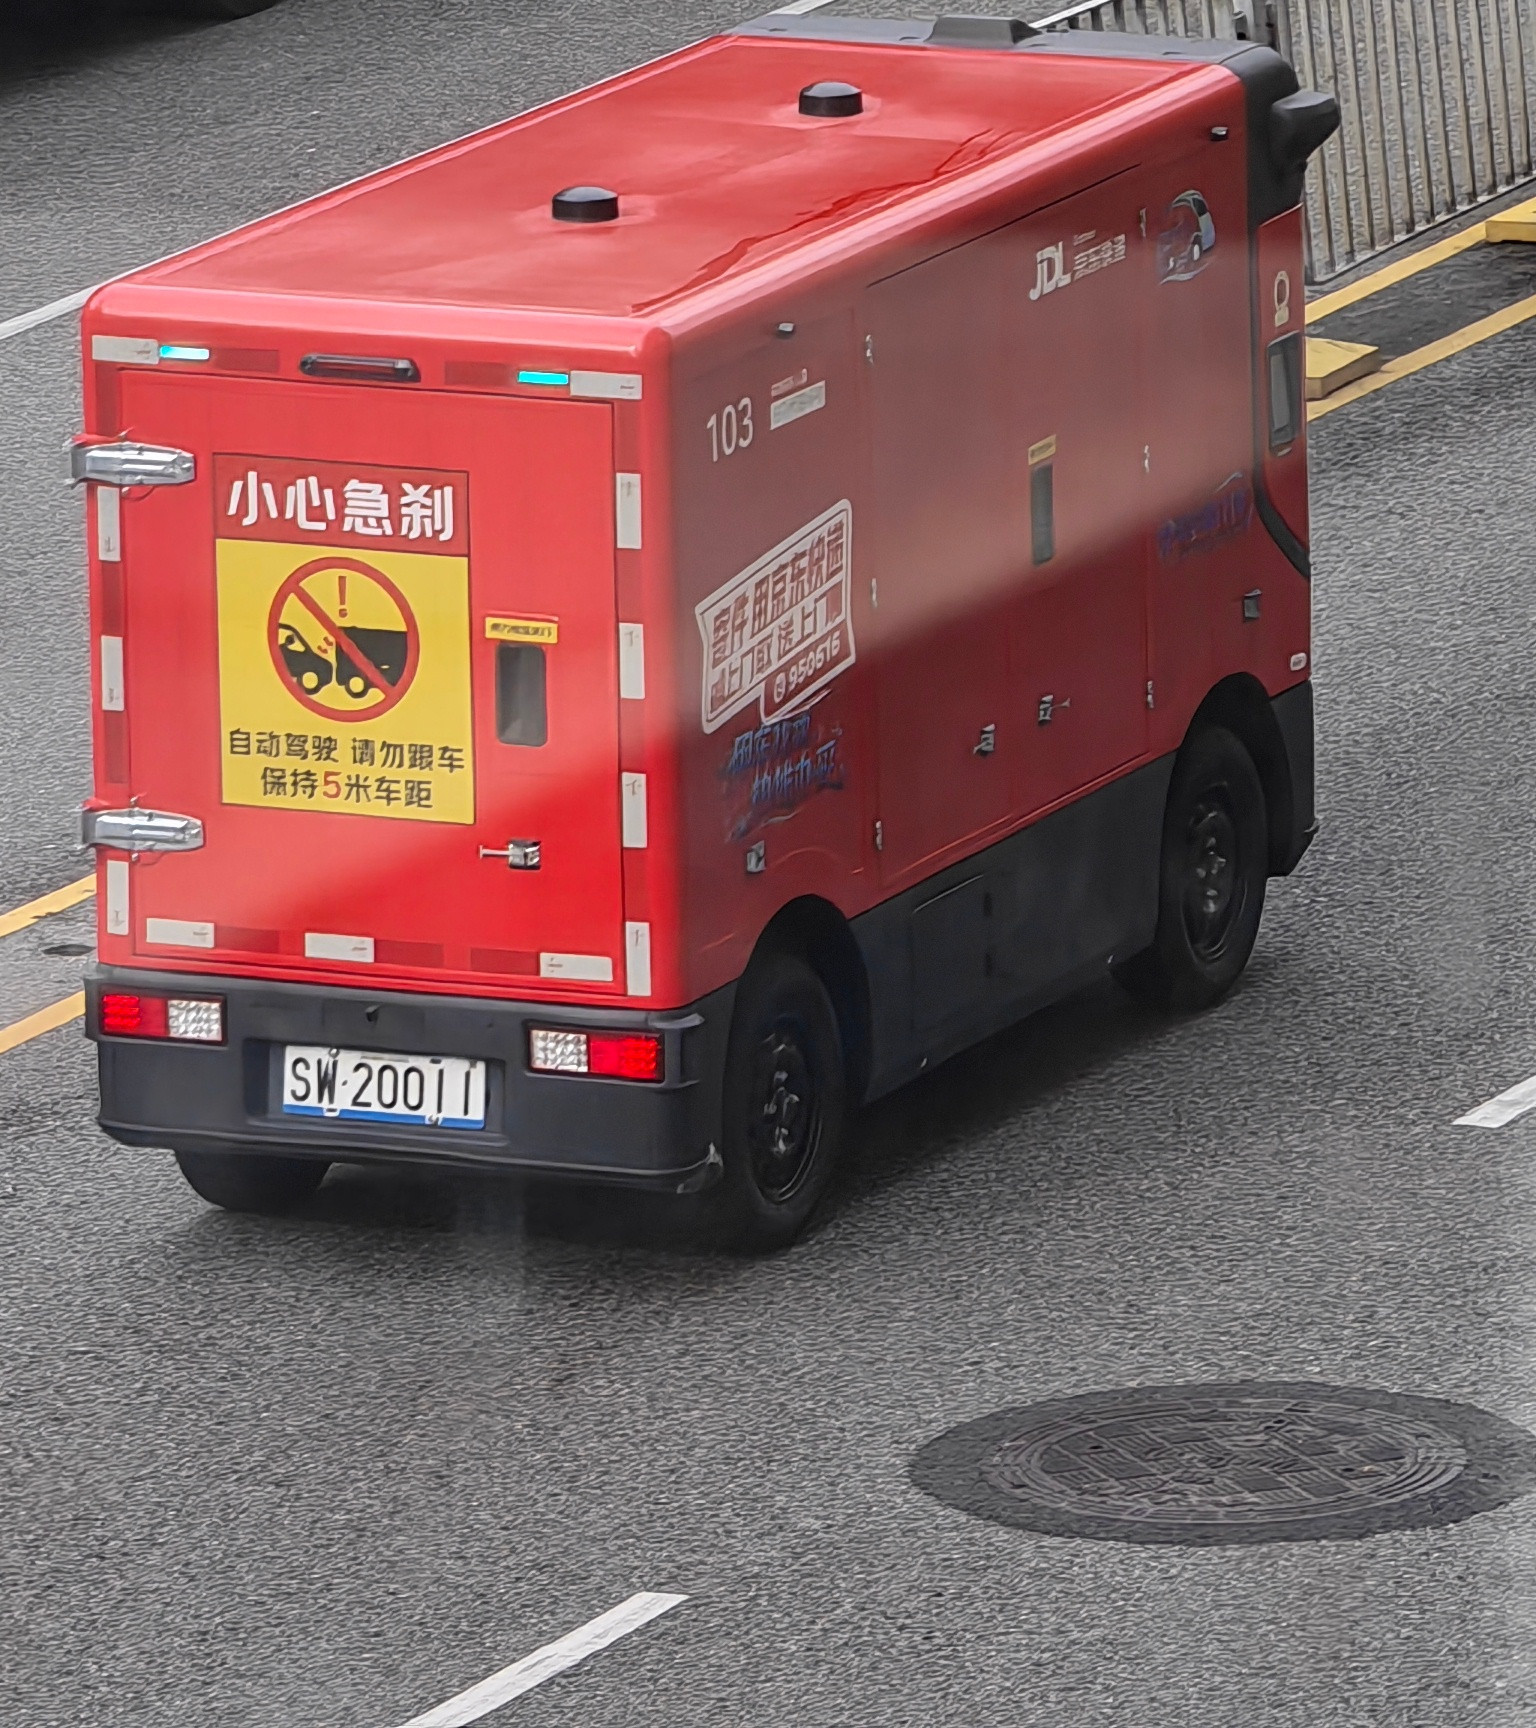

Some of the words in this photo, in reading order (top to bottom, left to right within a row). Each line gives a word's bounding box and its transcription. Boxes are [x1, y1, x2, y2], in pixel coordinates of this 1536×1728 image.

[1029, 241, 1072, 301] JDL
[706, 397, 754, 462] 103
[227, 470, 454, 541] 小心急刹
[229, 728, 339, 763] 自动驾驶
[351, 737, 465, 773] 请勿跟车
[261, 766, 434, 809] 保持5米车距
